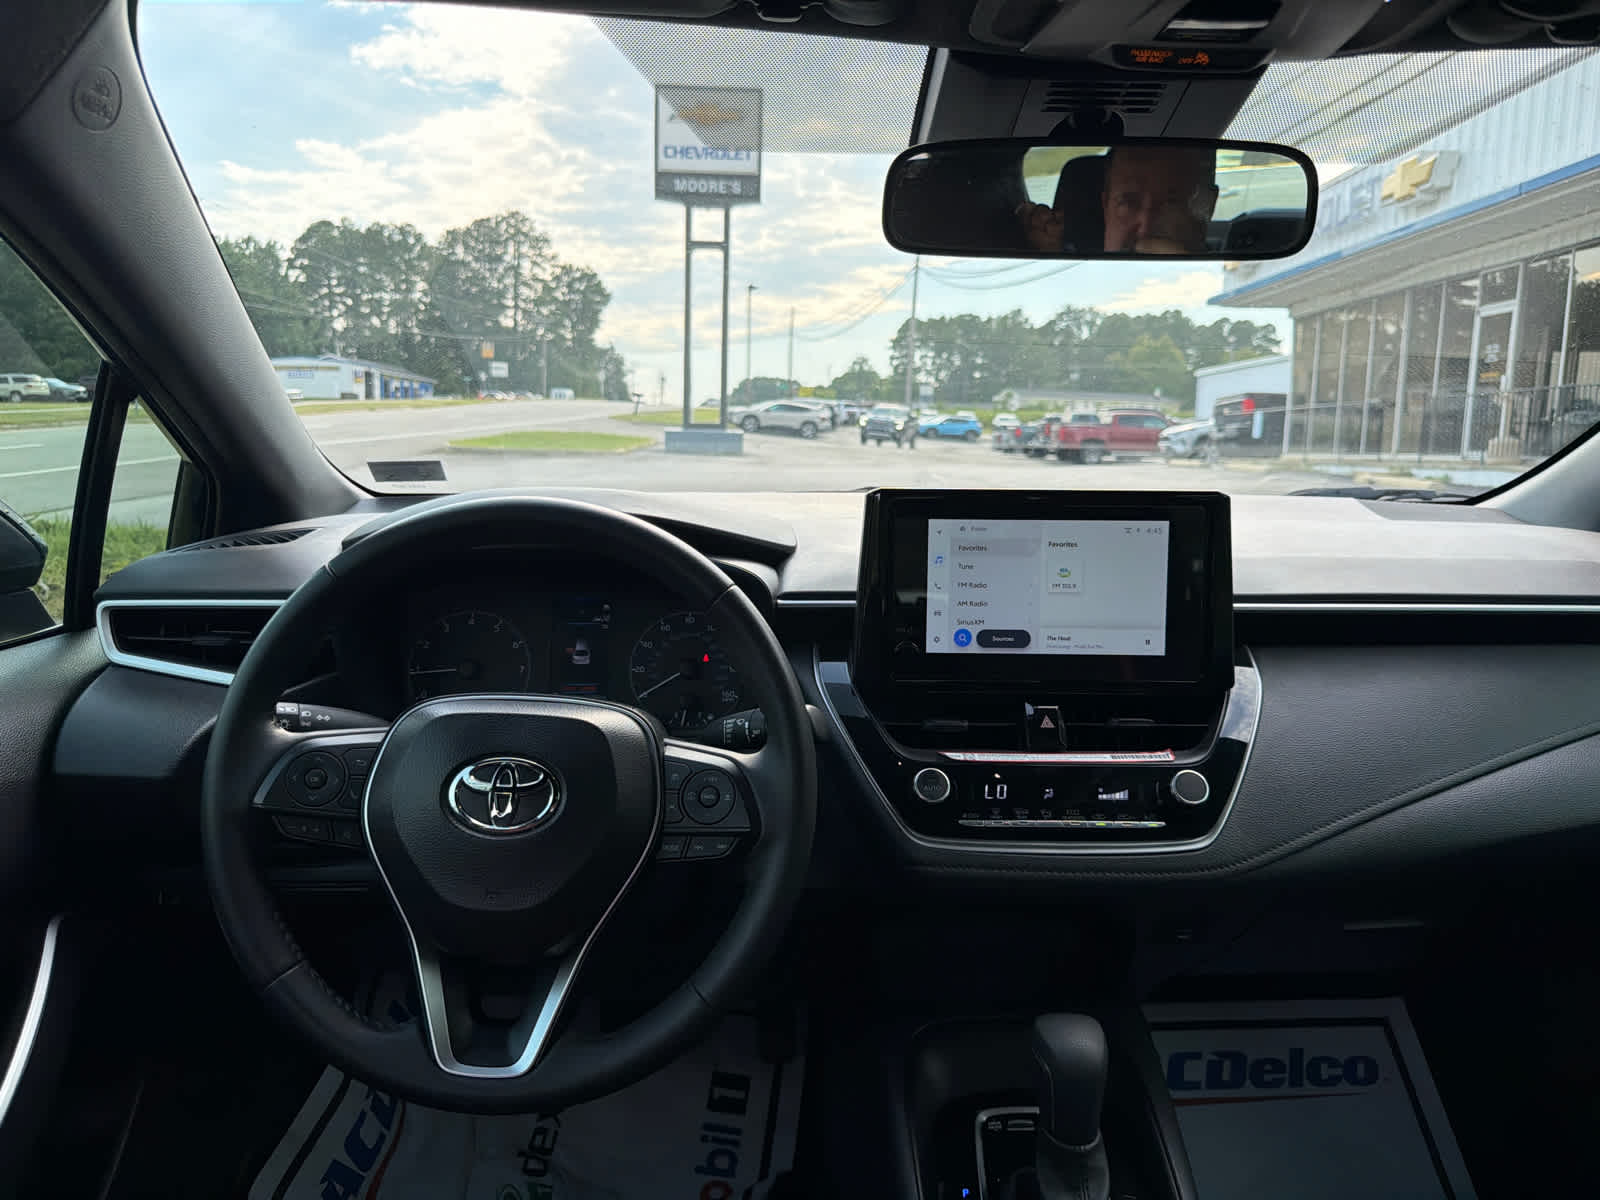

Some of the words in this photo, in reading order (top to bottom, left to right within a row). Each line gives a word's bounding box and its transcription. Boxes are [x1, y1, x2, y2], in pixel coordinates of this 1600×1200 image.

[663, 145, 751, 160] CHEVROLET
[673, 178, 742, 194] MOORE'S
[958, 544, 987, 552] Favorites
[958, 562, 974, 570] Tune
[958, 581, 968, 589] FM
[970, 581, 988, 589] Radio
[957, 618, 985, 626] SiriusXM
